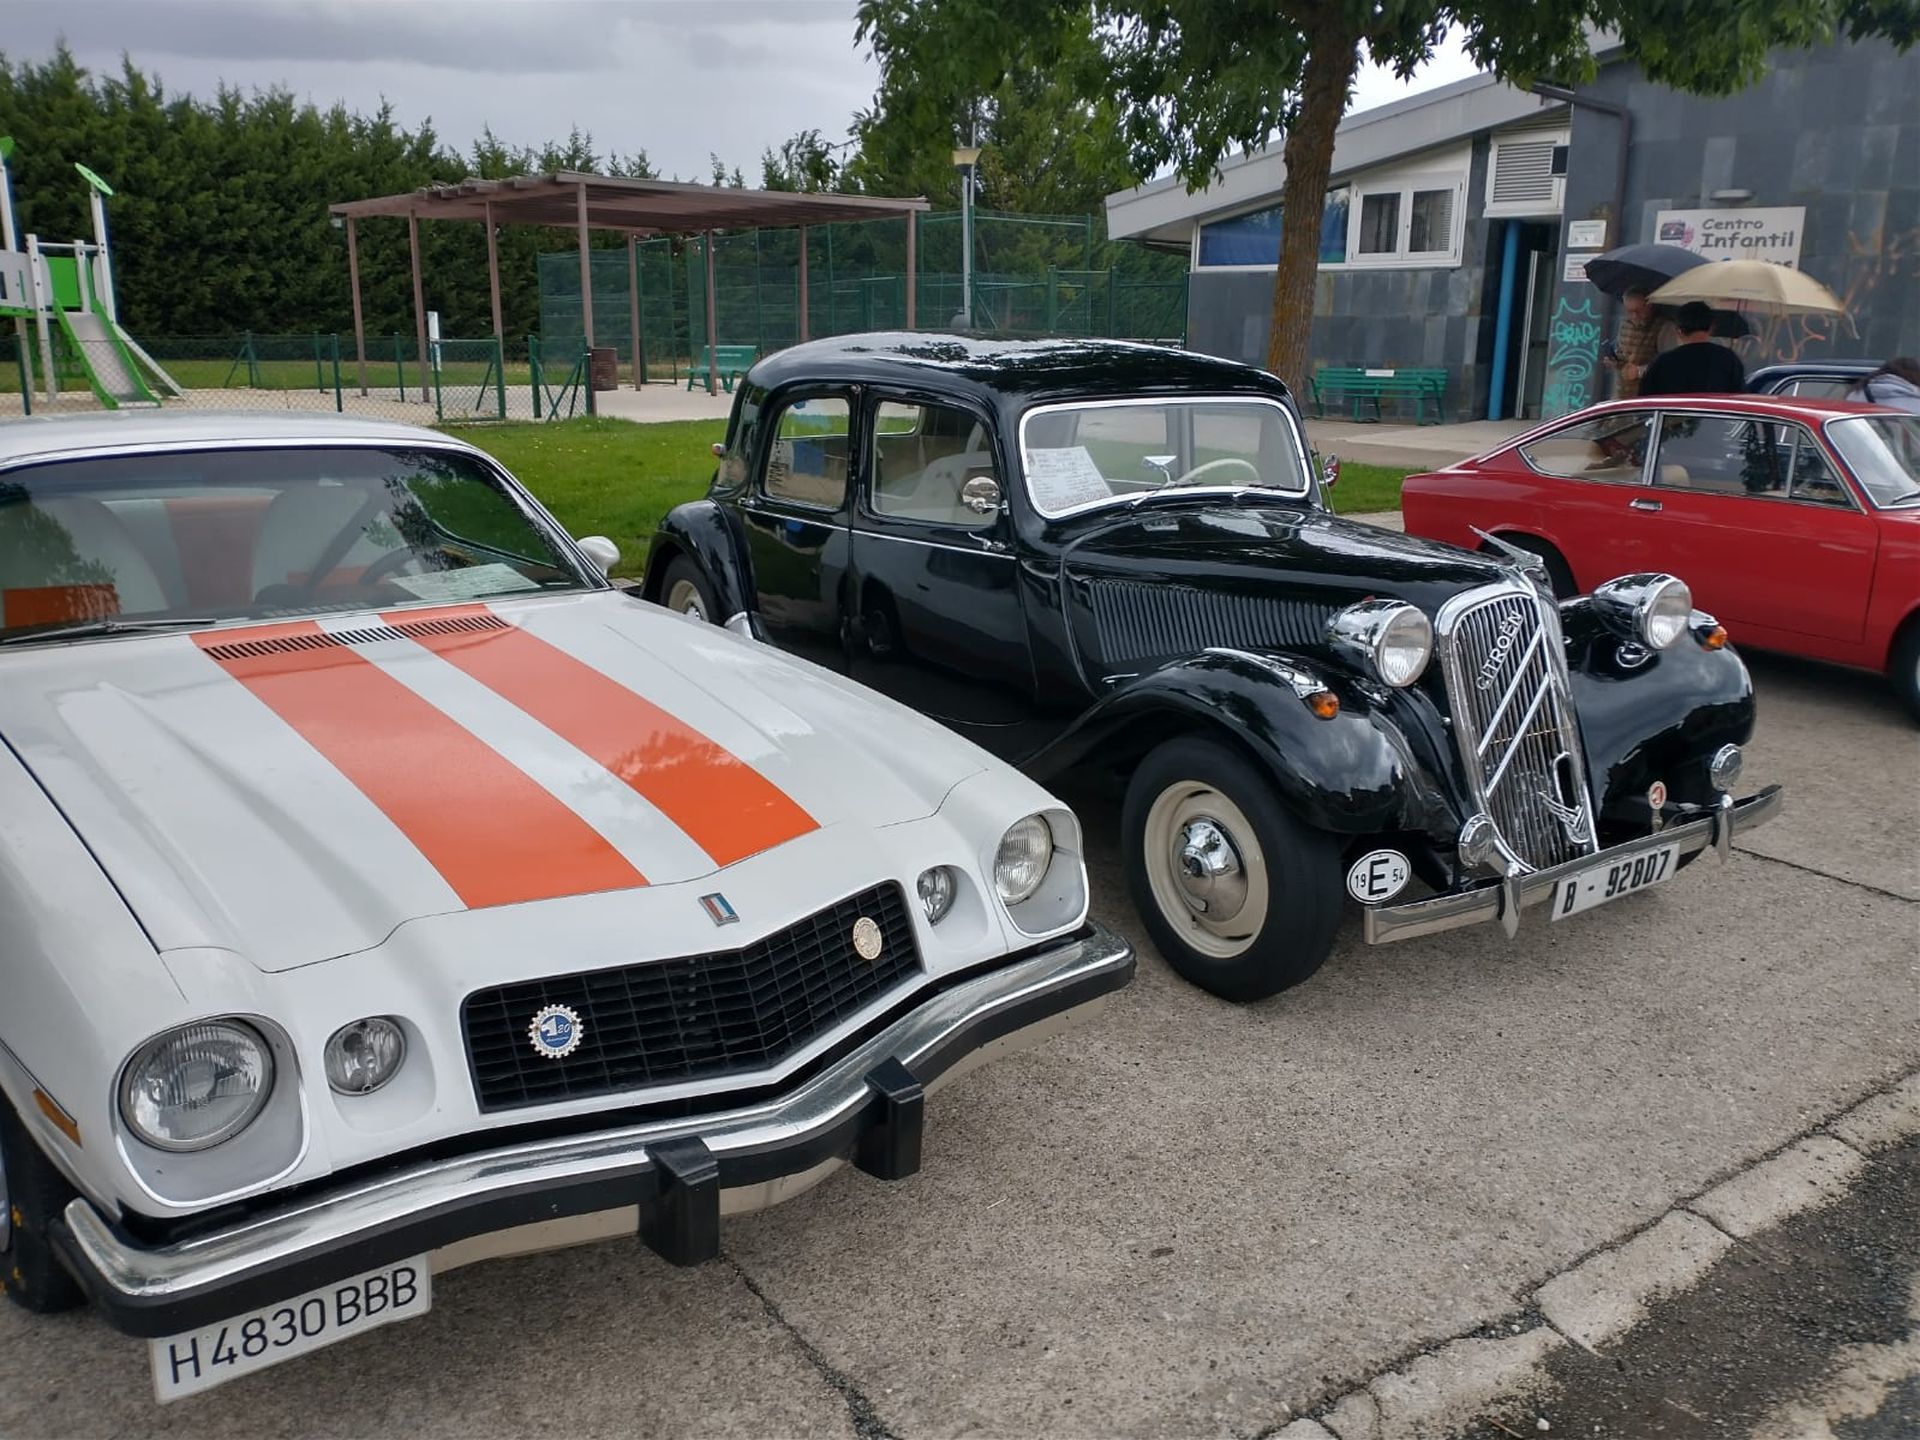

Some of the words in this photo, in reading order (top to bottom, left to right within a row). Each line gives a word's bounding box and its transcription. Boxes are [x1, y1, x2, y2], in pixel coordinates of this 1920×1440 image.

[1700, 231, 1794, 248] Infantil
[1702, 218, 1764, 230] Centro
[1476, 609, 1524, 691] CITROËN
[1355, 873, 1366, 888] 19
[1368, 858, 1390, 895] E
[1562, 881, 1577, 914] B
[1605, 849, 1671, 897] 92807
